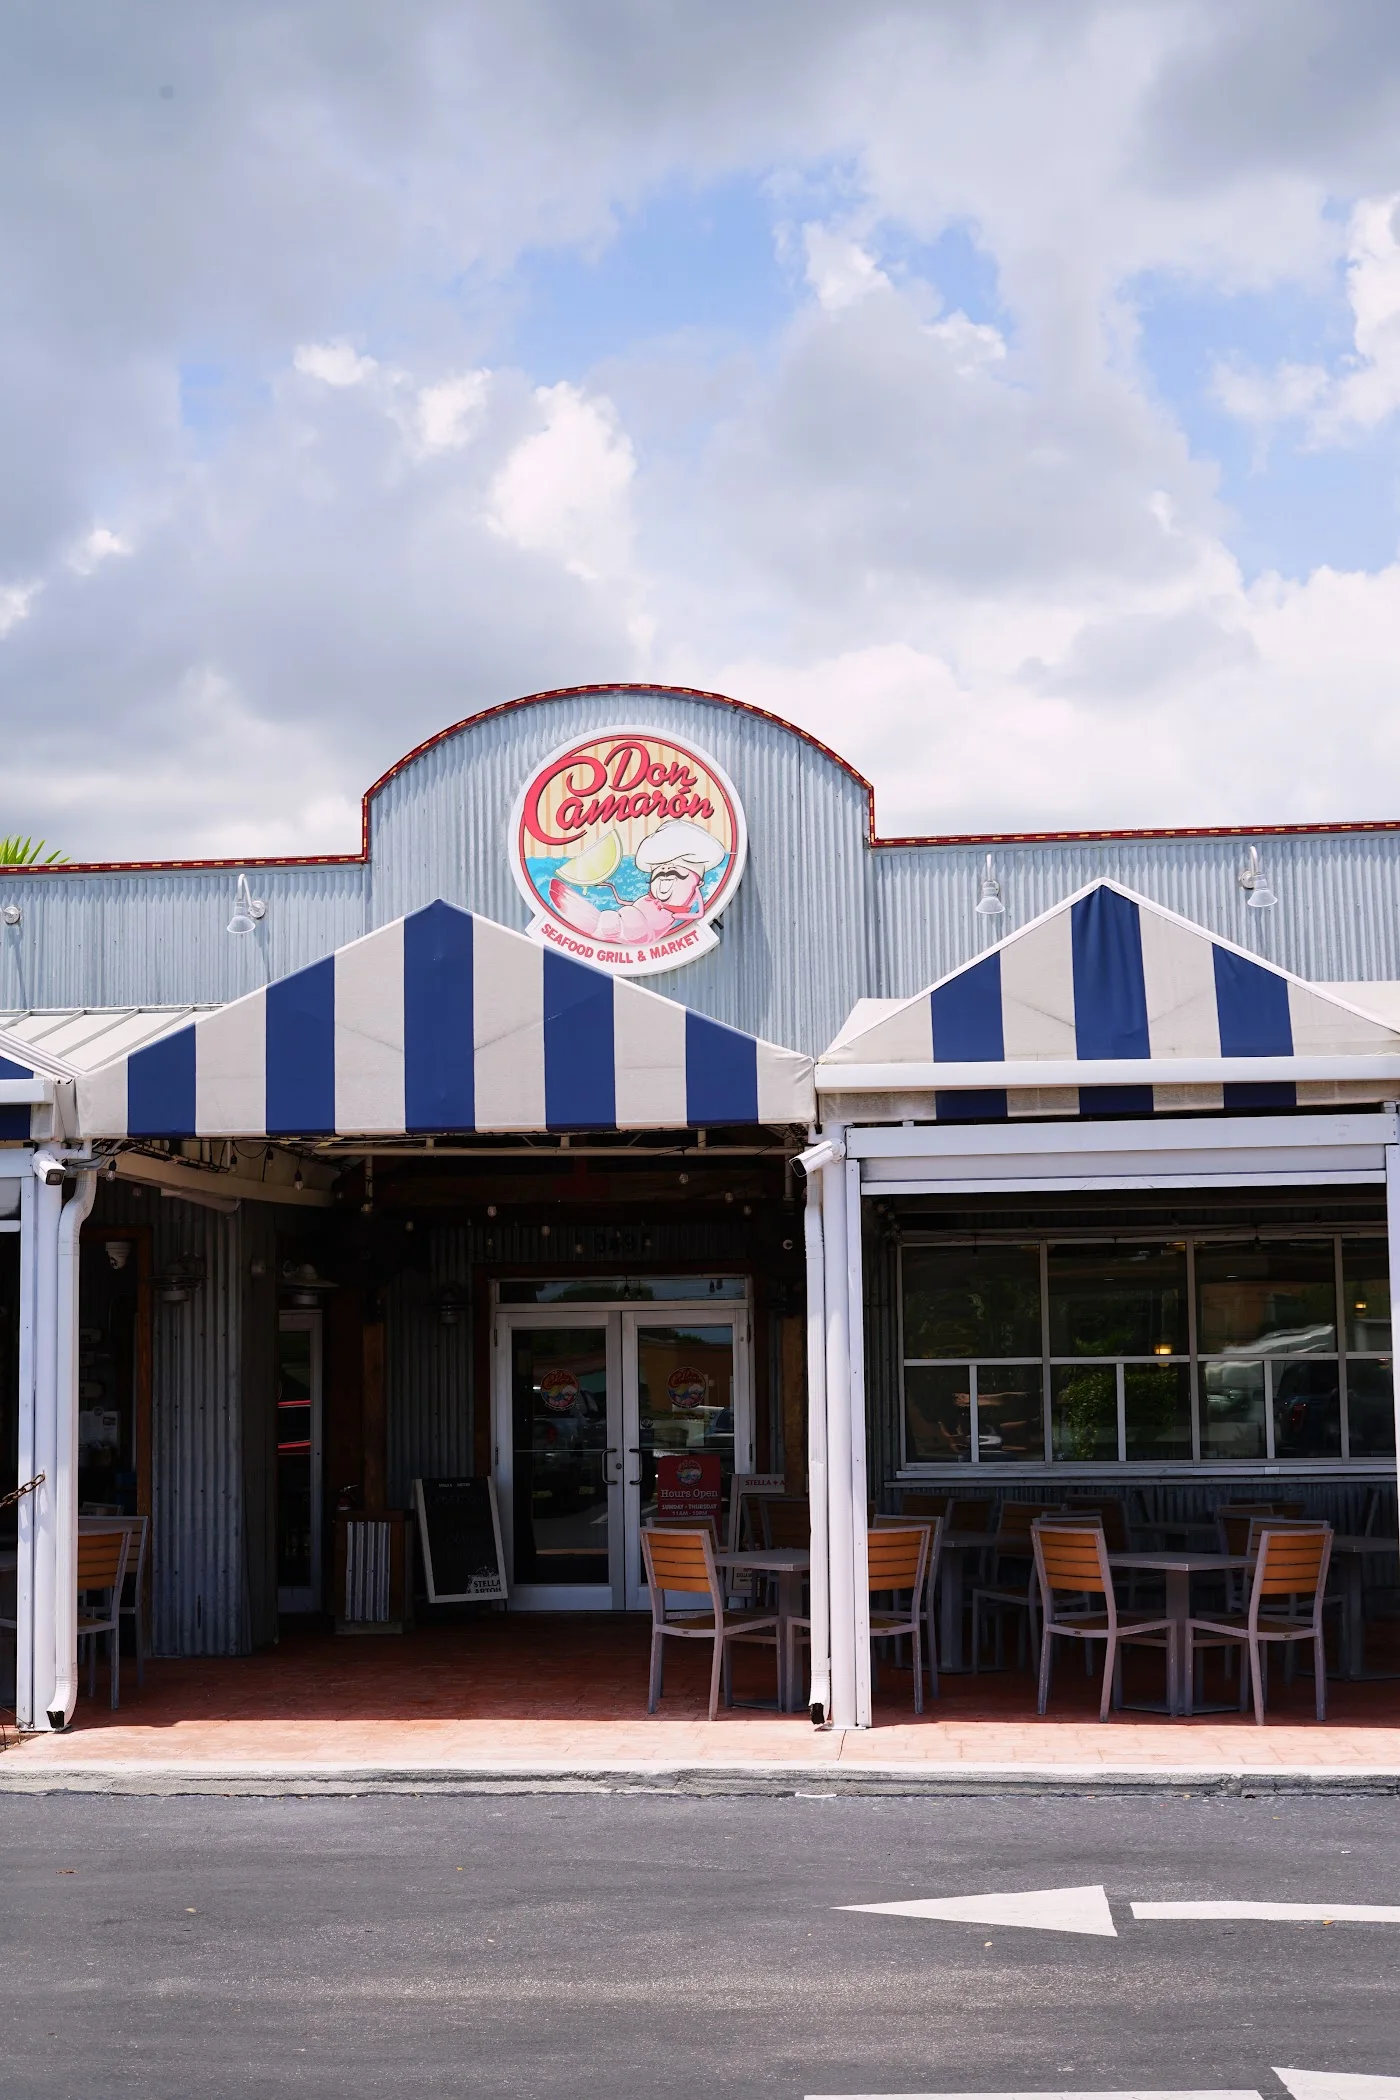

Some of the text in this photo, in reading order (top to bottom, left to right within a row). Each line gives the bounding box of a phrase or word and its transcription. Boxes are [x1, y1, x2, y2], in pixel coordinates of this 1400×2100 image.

[604, 741, 698, 792] Don
[524, 755, 714, 846] Camarón
[541, 923, 700, 964] SEAFOOD GRILL & MARKET
[660, 1488, 718, 1499] Hours Open
[473, 1579, 501, 1588] STELLA
